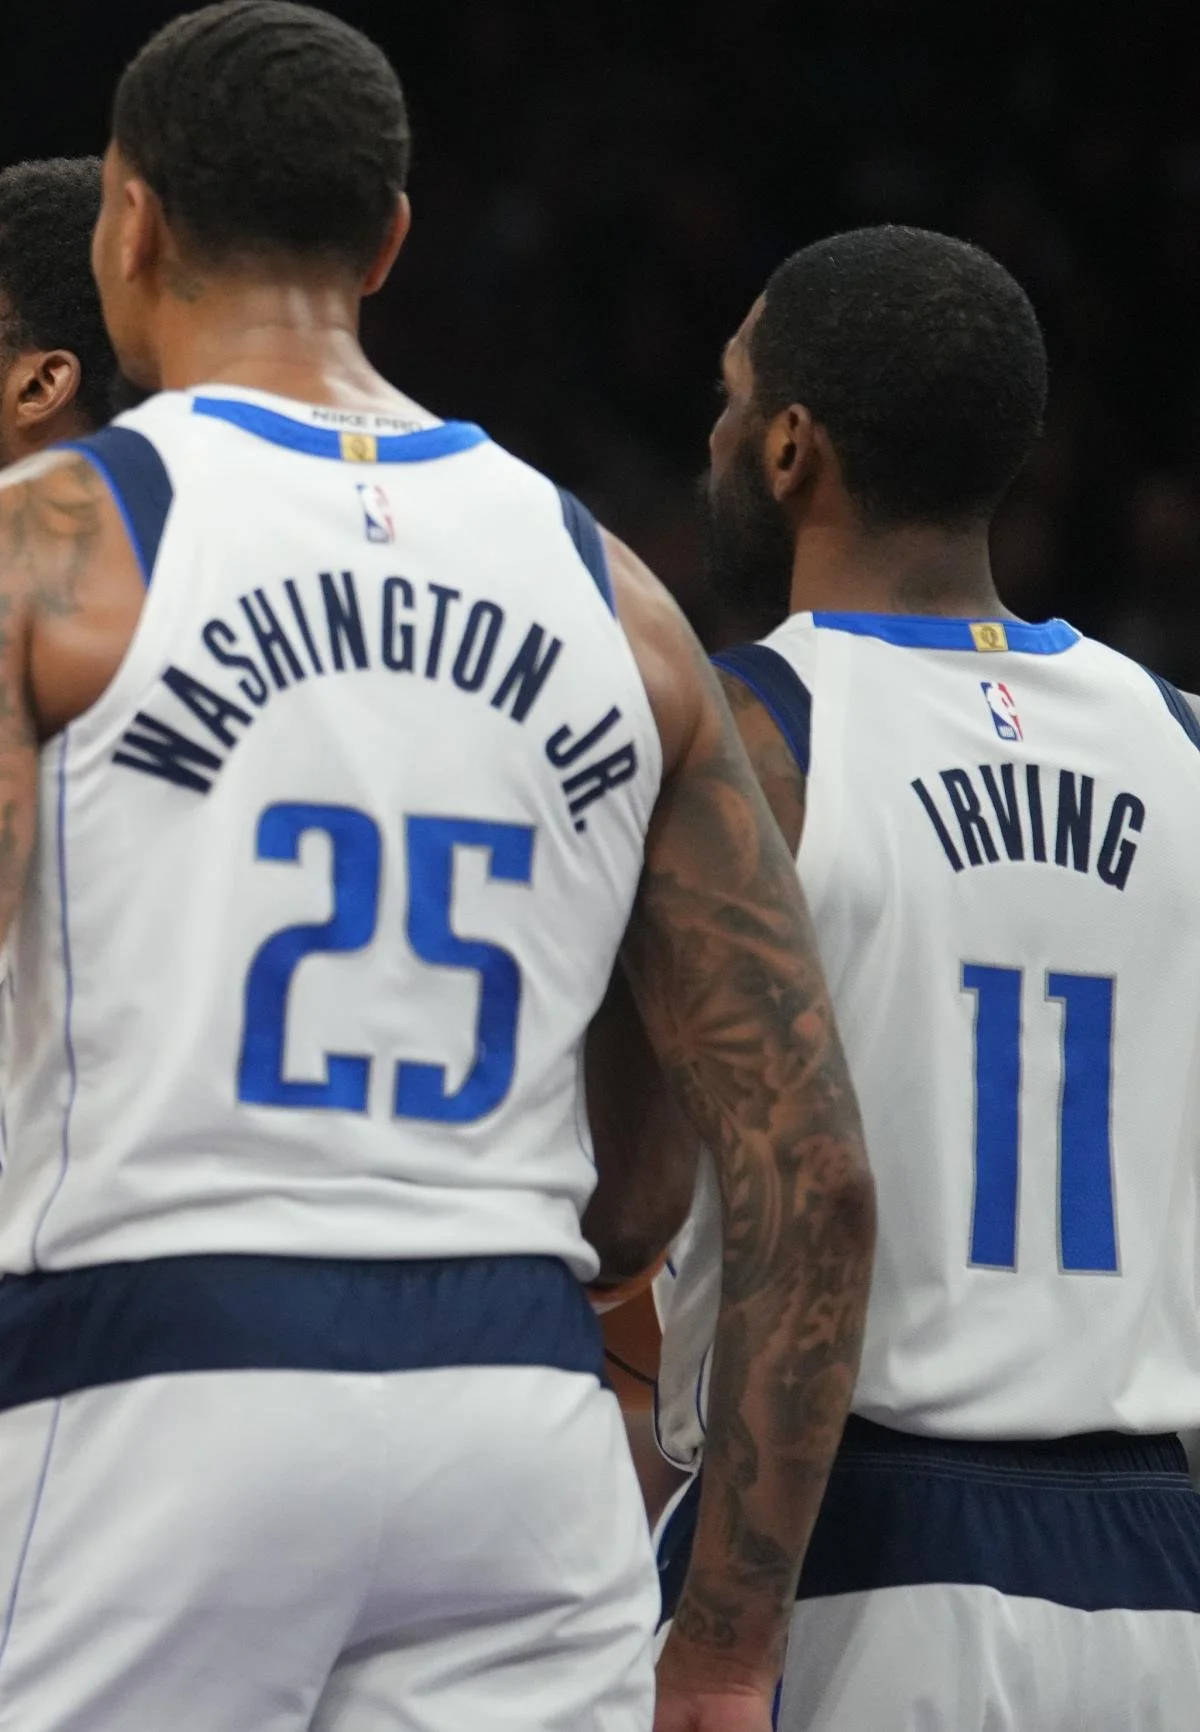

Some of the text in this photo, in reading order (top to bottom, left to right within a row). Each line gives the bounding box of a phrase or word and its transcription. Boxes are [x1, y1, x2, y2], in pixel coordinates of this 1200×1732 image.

[312, 408, 366, 428] NIKE
[112, 571, 638, 833] WASHINGTON JR.
[911, 763, 1146, 891] IRVING
[236, 801, 537, 1126] 25
[960, 960, 1121, 1276] 11
